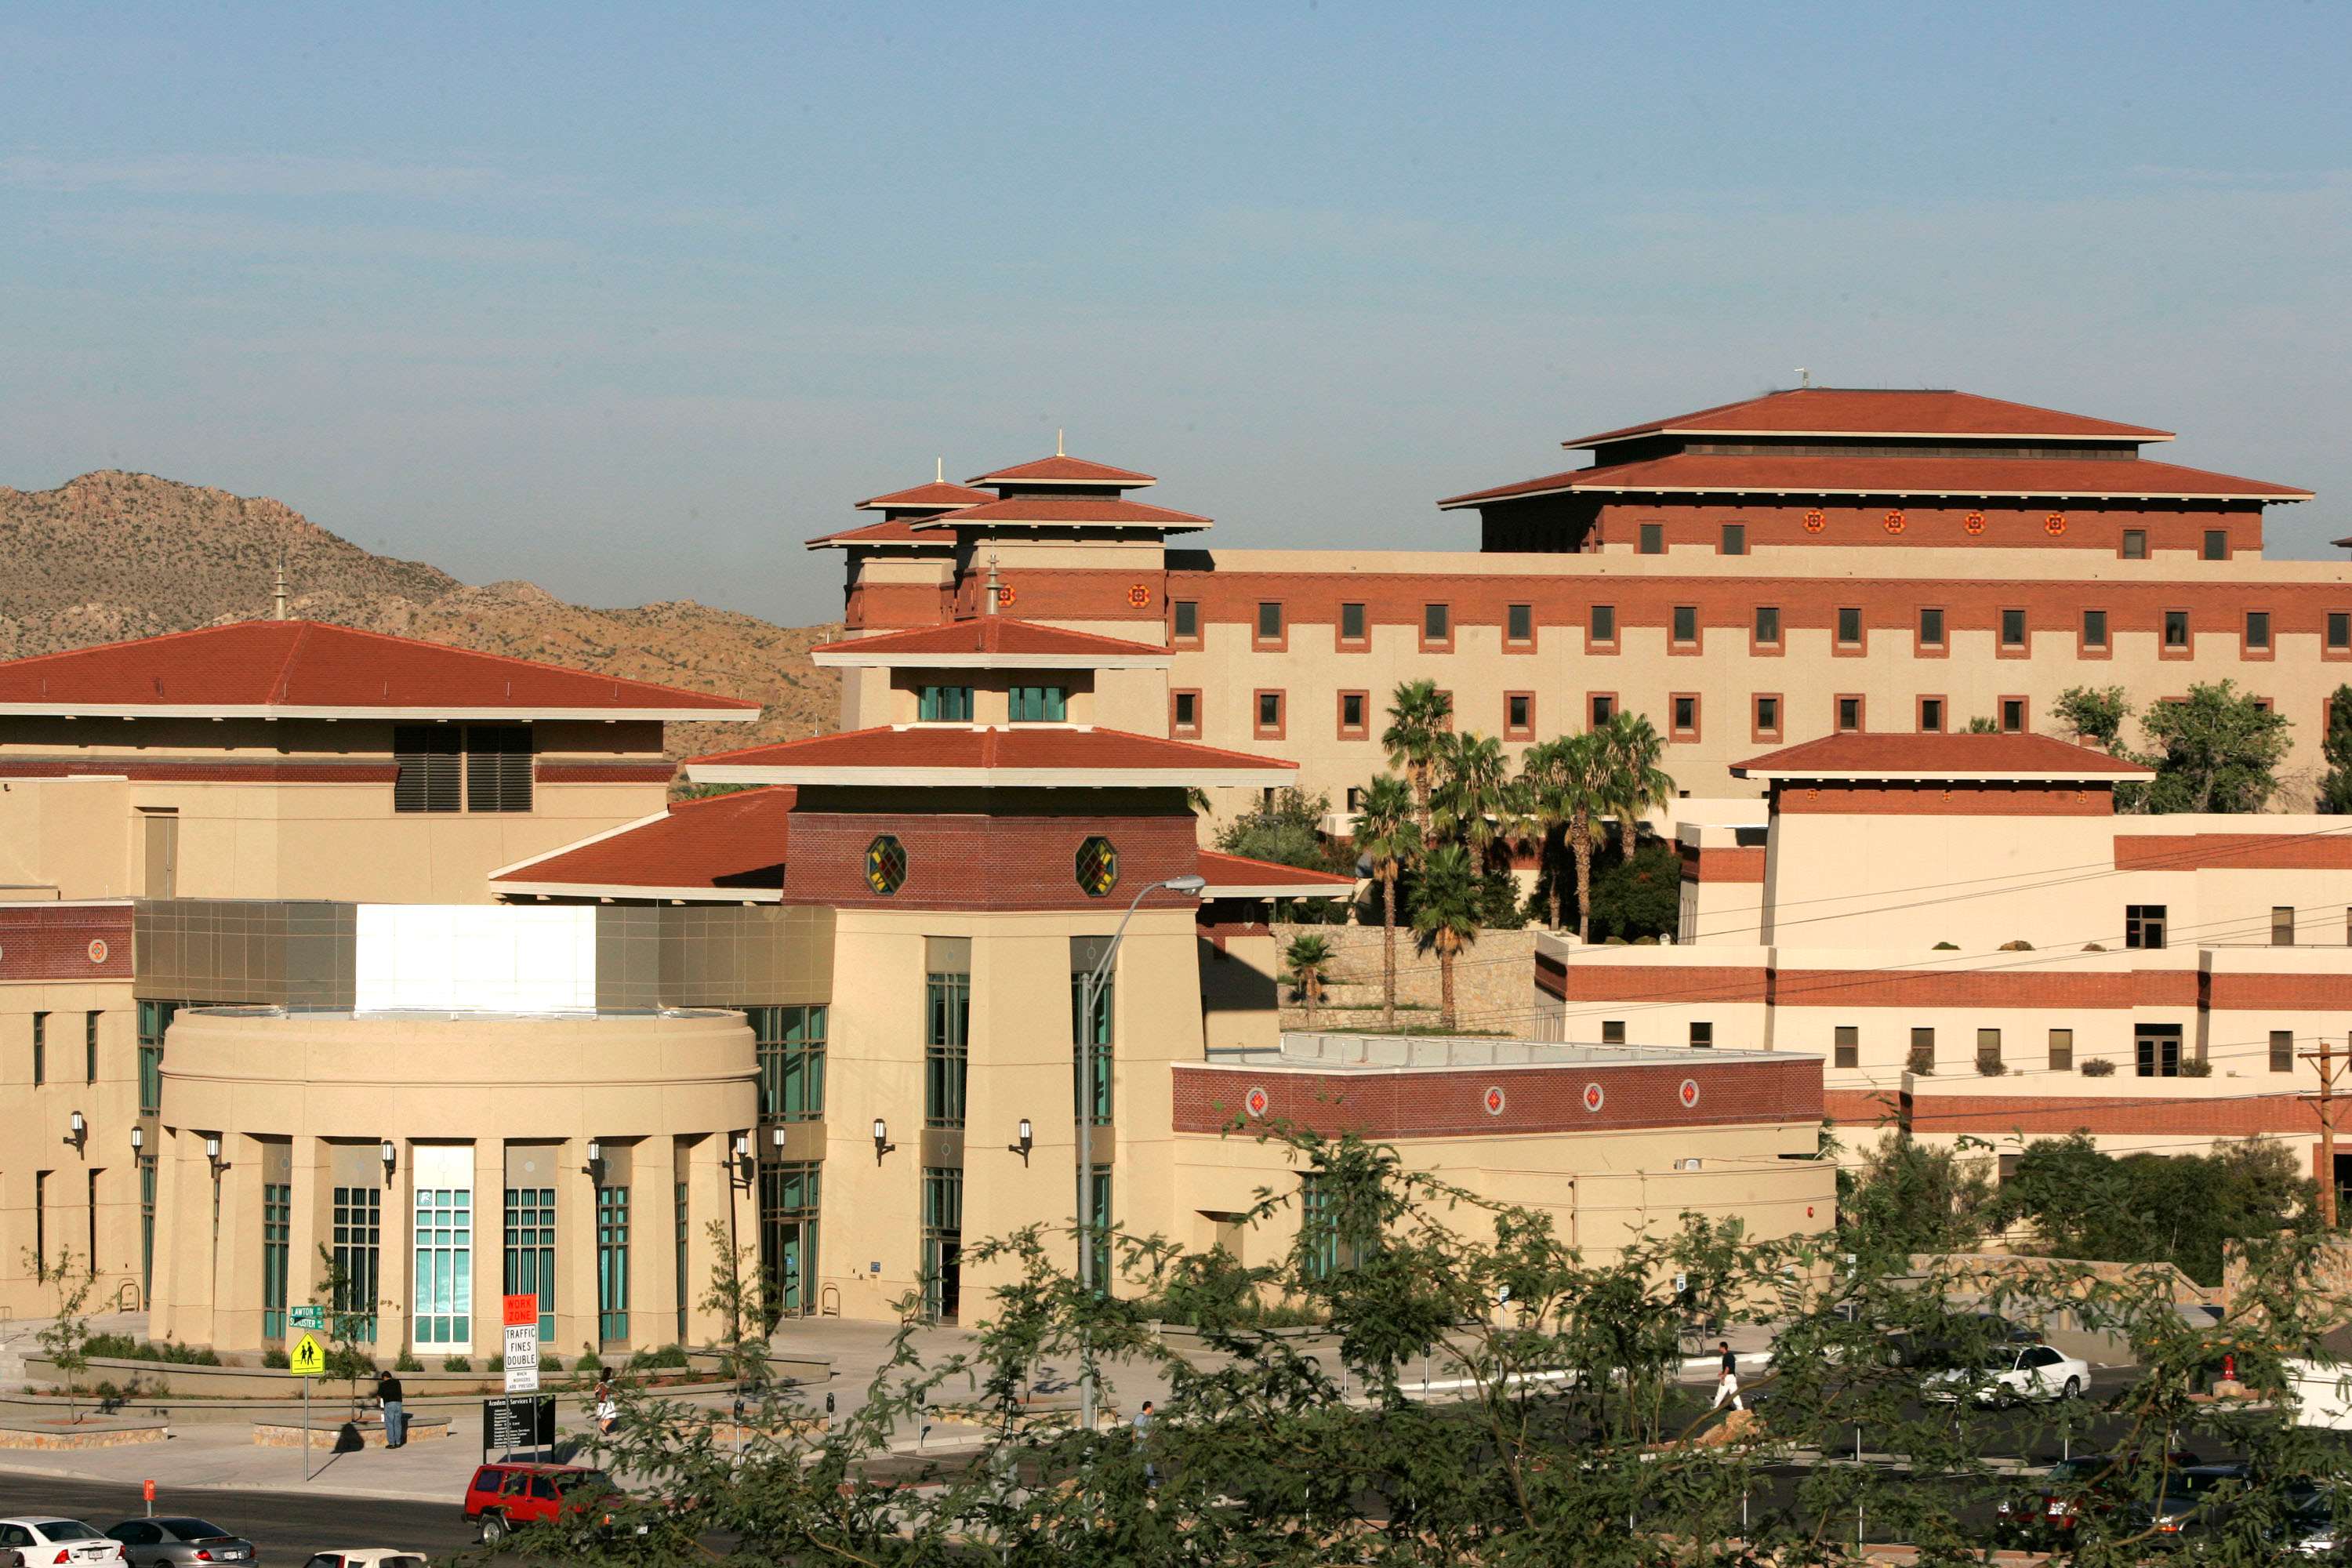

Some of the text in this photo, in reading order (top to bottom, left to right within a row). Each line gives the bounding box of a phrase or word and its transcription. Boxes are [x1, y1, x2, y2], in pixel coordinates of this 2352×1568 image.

[508, 1299, 532, 1308] WORK
[291, 1308, 314, 1316] LAWTON
[510, 1311, 531, 1321] ZONE
[290, 1318, 315, 1327] SUSTER
[506, 1328, 535, 1339] TRAFFIC
[511, 1341, 531, 1352] FINES
[507, 1355, 535, 1366] DOUBLE
